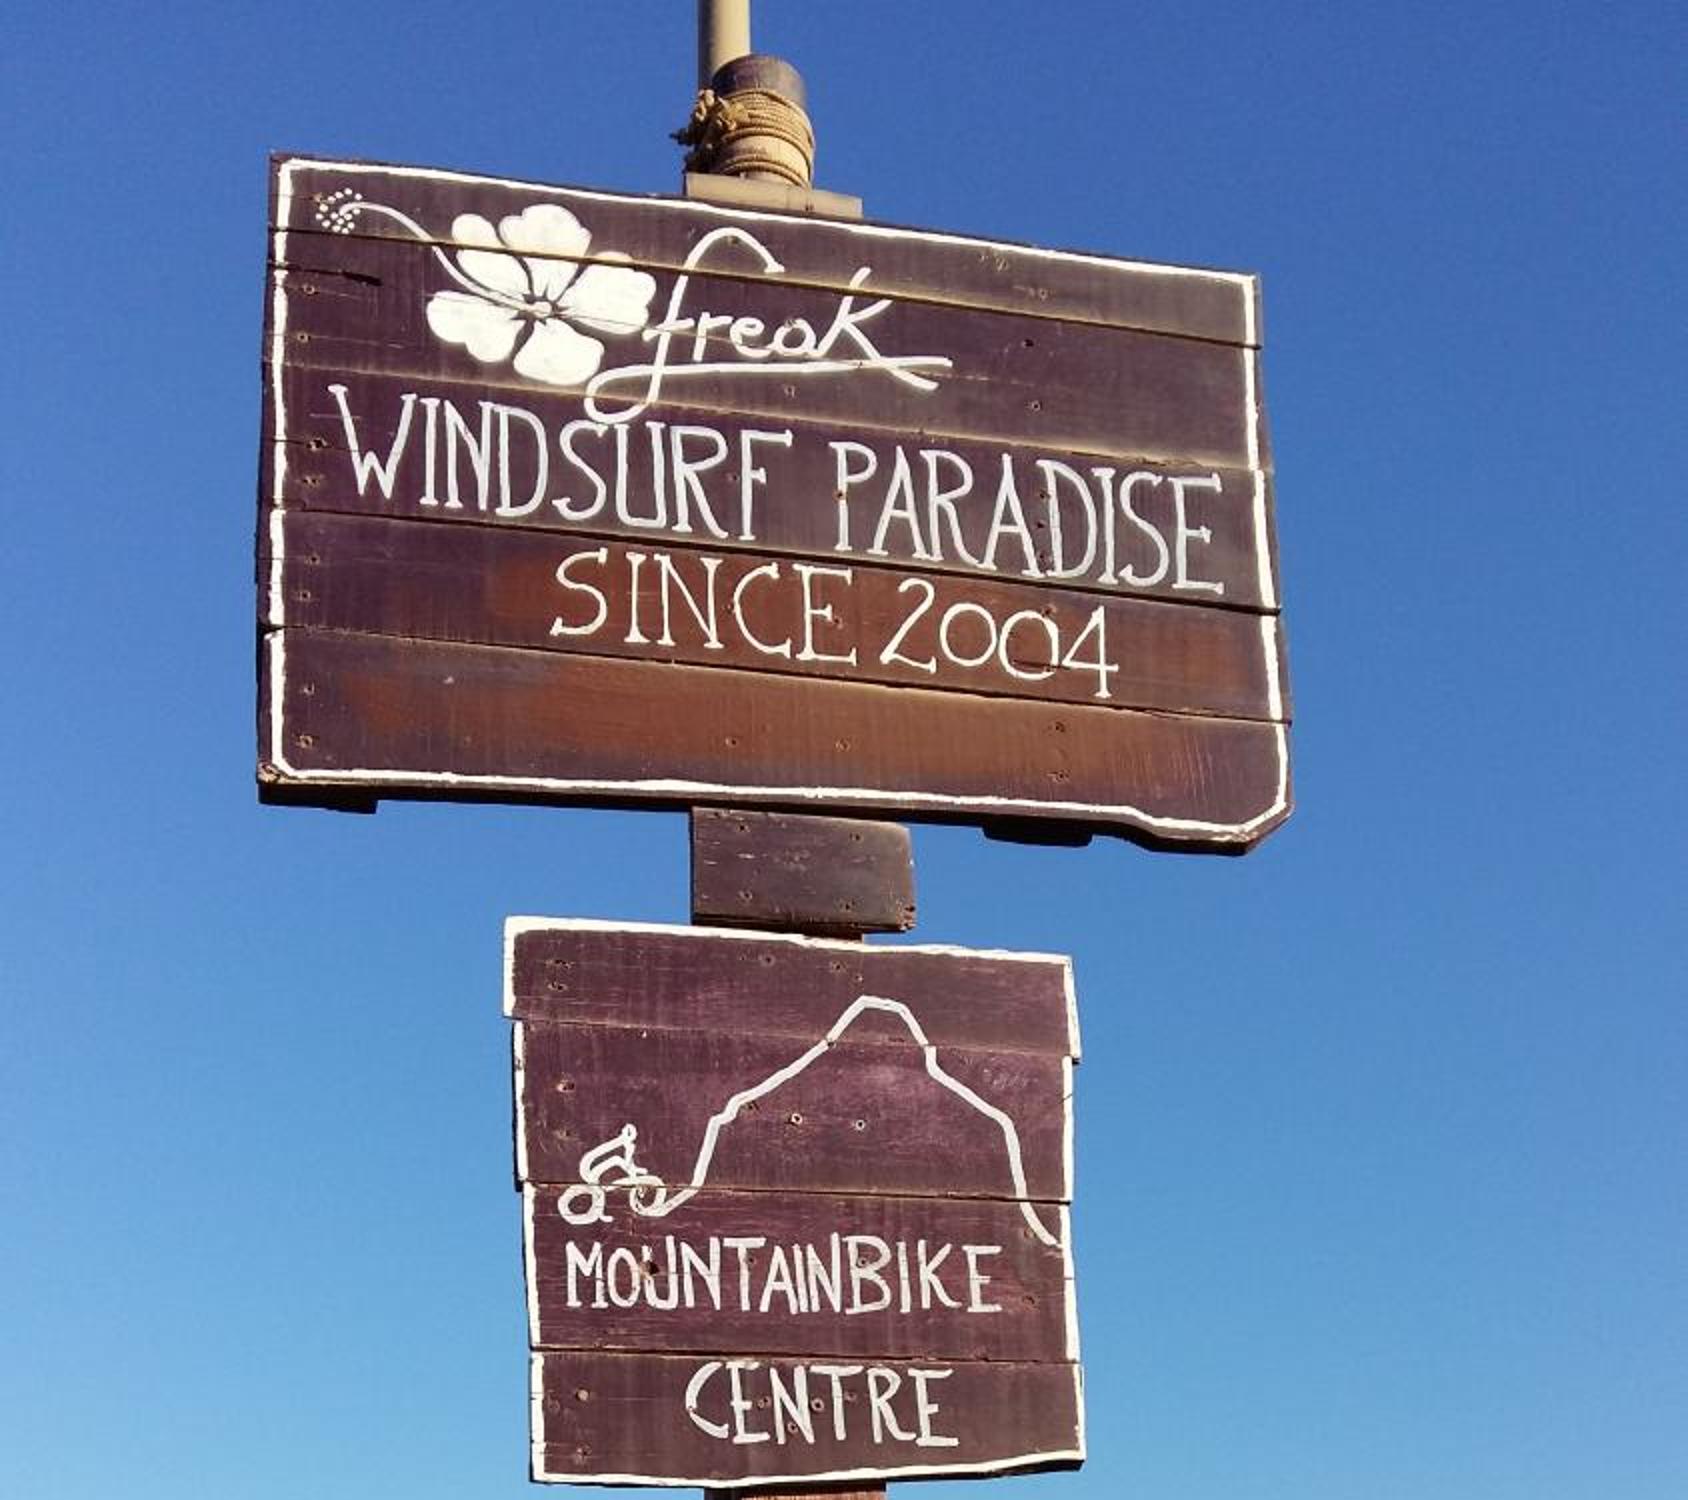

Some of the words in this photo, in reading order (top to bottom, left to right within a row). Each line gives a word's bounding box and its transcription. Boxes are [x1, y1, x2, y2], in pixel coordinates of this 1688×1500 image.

[327, 384, 794, 541] WINDSURF
[833, 441, 1227, 597] PARADISE
[550, 548, 859, 666] SINCE
[879, 577, 1120, 700] 2004
[565, 1232, 1003, 1316] MOUNTAINBIKE
[686, 1361, 960, 1447] CENTRE
